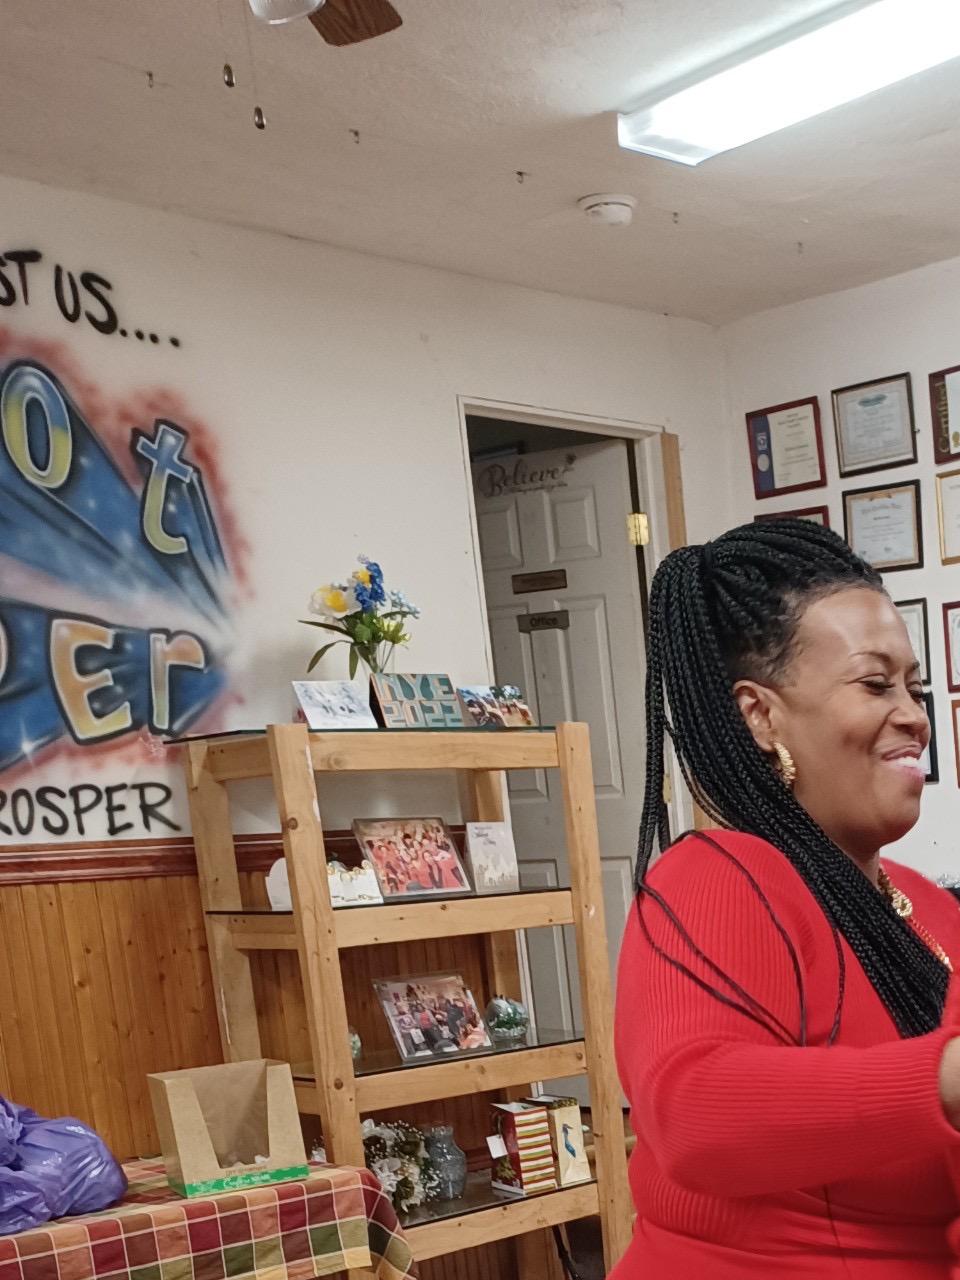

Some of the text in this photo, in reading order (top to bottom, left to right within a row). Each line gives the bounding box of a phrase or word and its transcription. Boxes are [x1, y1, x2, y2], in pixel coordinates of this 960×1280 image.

[477, 458, 560, 498] Believe
[529, 615, 558, 629] Office
[374, 674, 457, 701] NYE
[382, 701, 464, 728] 2022
